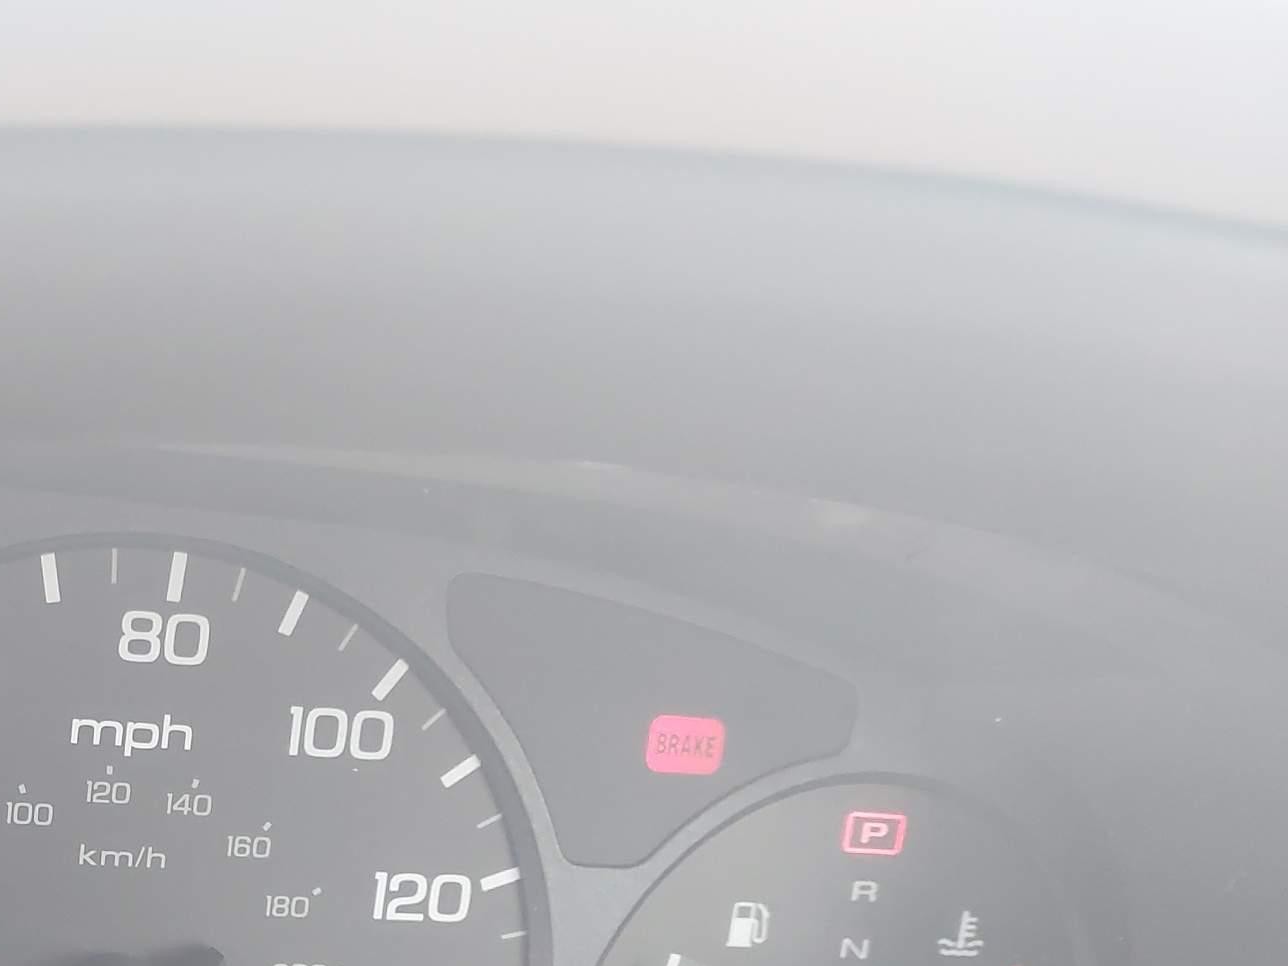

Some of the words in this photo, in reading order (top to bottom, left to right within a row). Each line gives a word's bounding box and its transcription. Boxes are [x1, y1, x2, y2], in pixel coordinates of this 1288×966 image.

[118, 611, 210, 666] 80
[70, 715, 193, 756] mph
[289, 706, 394, 760] 100
[656, 733, 717, 757] BRAKE
[86, 781, 131, 804] 120
[166, 793, 212, 816] 140
[6, 802, 54, 826] 100
[861, 822, 888, 843] P
[79, 843, 167, 869] km/h
[227, 836, 271, 858] 160
[373, 872, 472, 922] 120
[850, 881, 878, 903] R
[265, 895, 309, 919] 180
[840, 938, 870, 959] N
